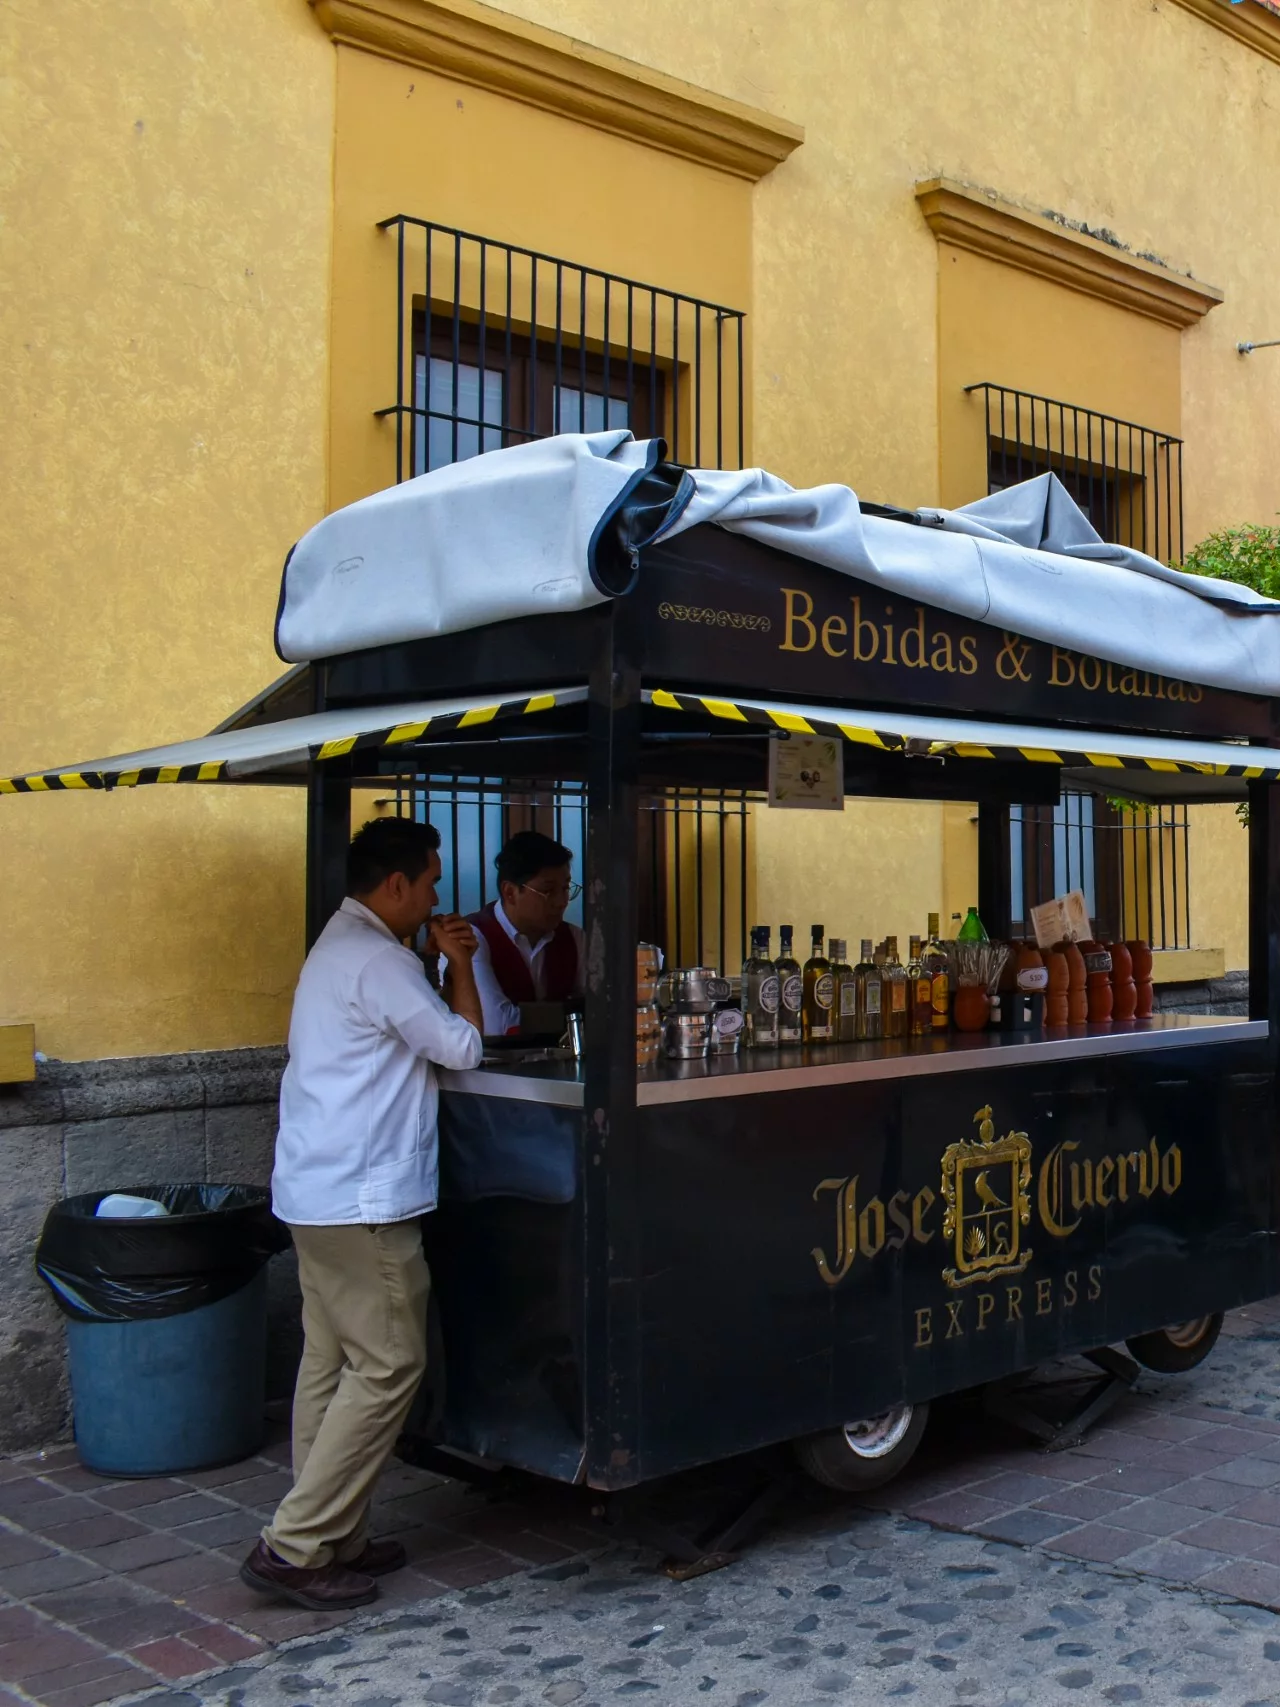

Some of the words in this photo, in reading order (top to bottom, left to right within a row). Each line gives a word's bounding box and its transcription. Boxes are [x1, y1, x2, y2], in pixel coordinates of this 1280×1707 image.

[778, 587, 978, 675] Bebidas
[995, 630, 1032, 683] &
[811, 1174, 936, 1288] Jose
[1038, 1134, 1183, 1237] Cuervo
[913, 1265, 1104, 1349] EXPRESS
